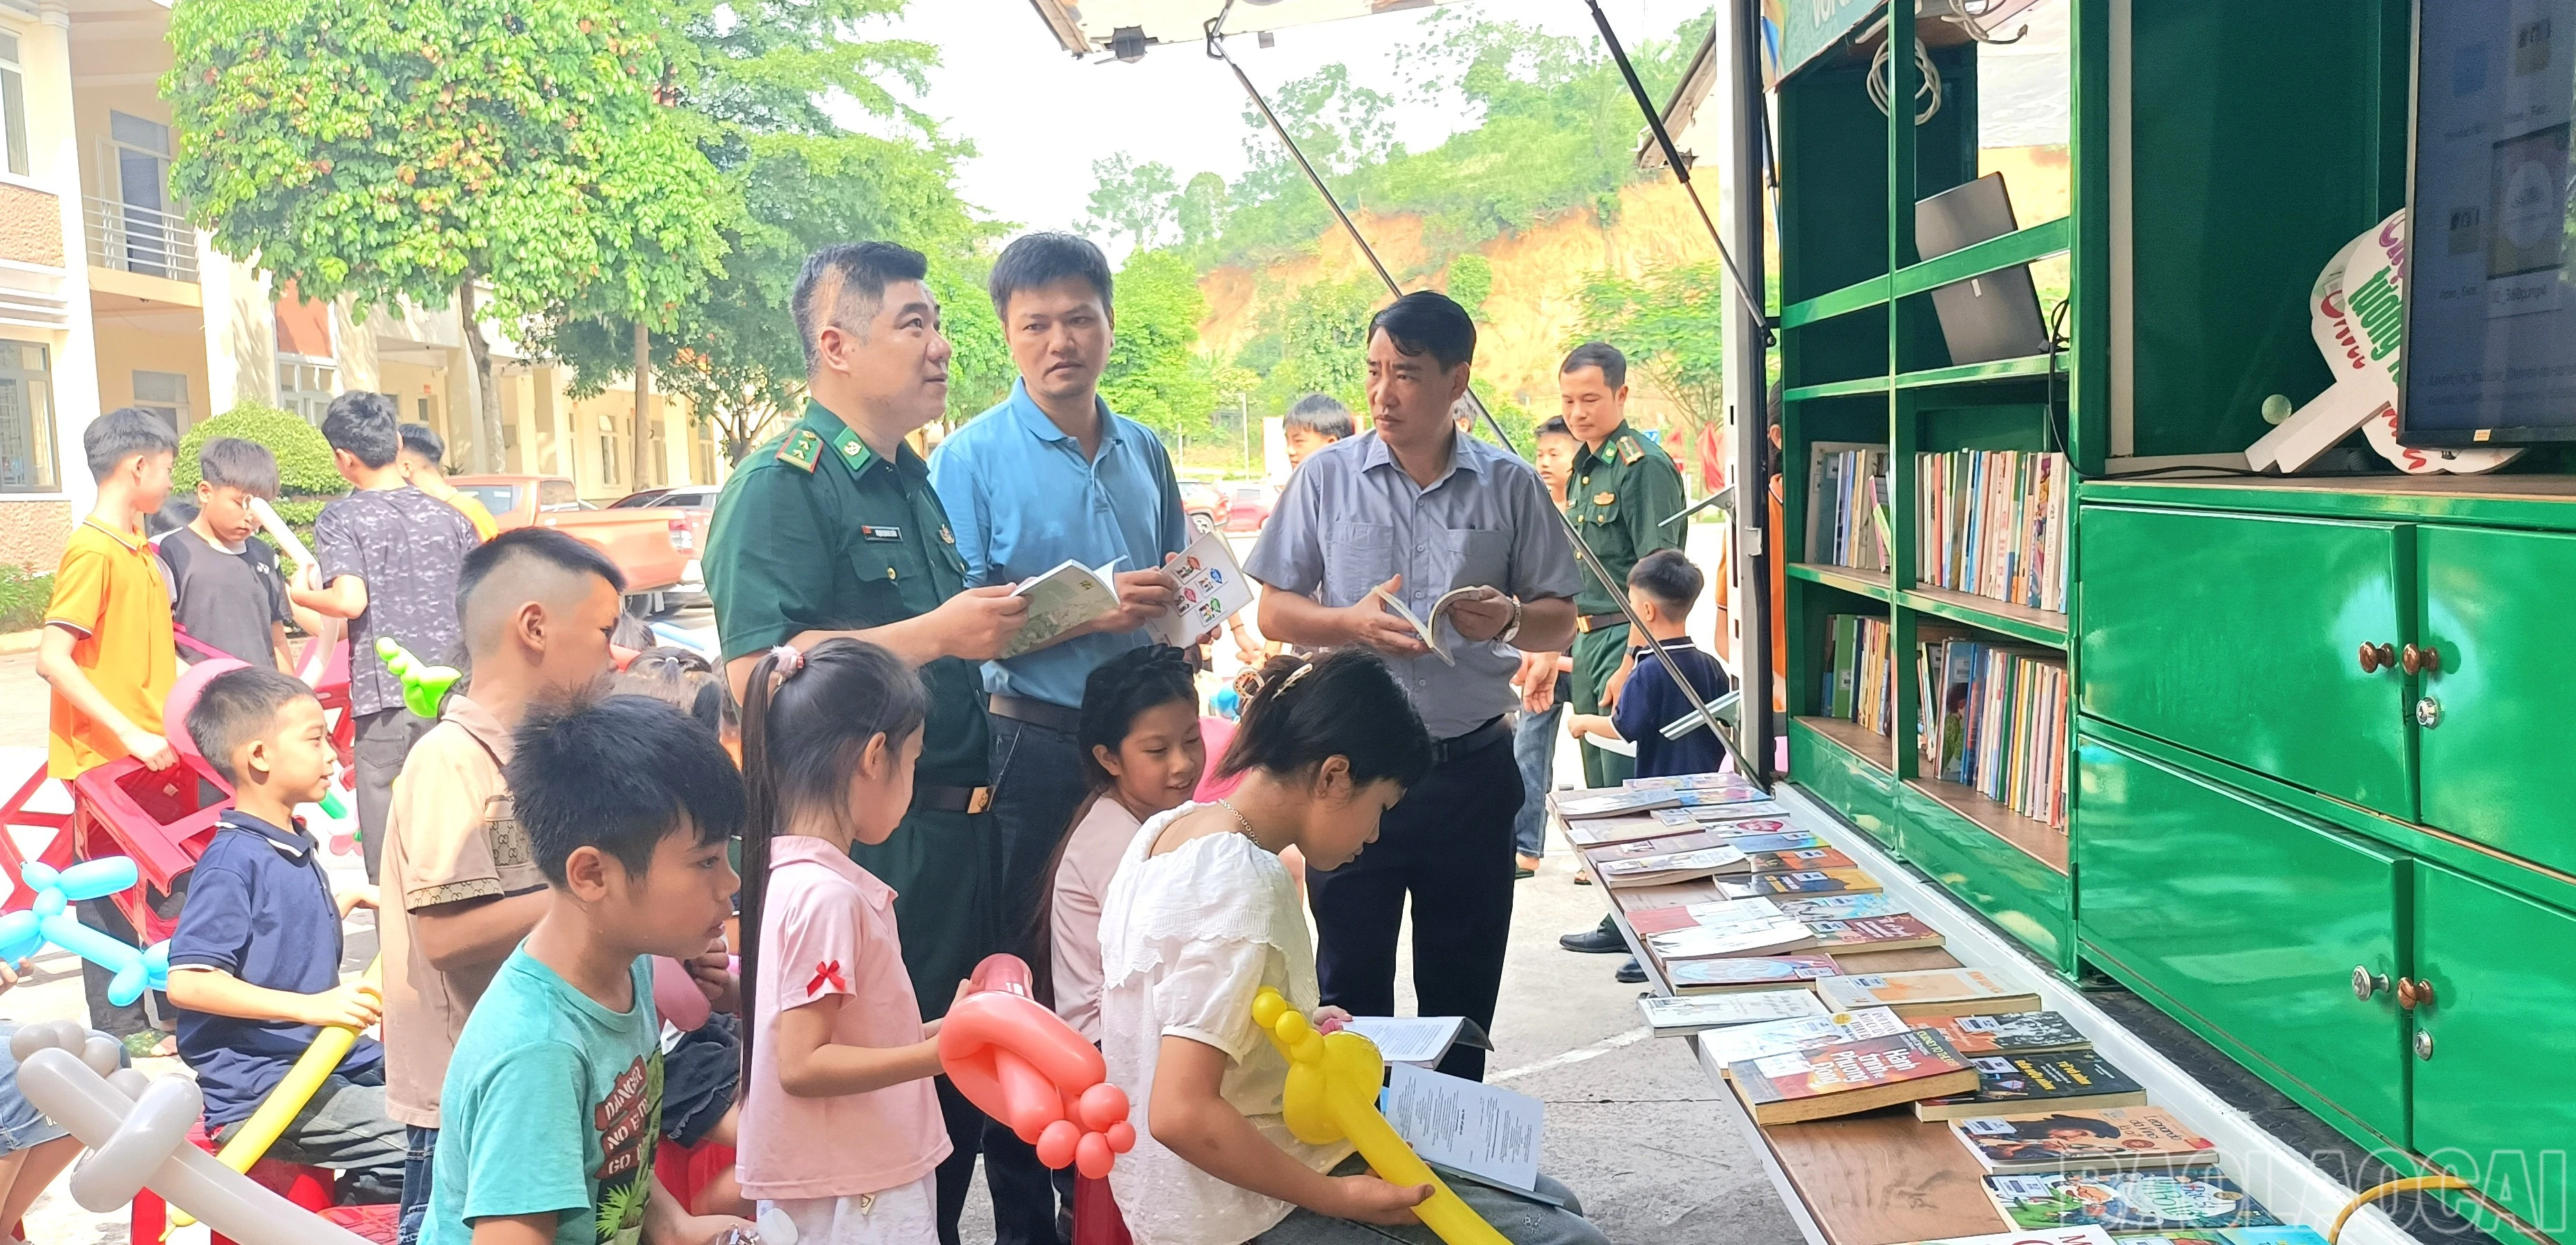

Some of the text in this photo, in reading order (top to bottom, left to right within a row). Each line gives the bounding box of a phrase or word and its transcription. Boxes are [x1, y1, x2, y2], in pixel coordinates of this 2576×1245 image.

[1858, 1053, 1894, 1074] trình
[1882, 1048, 1922, 1071] Hành
[607, 1125, 629, 1150] NO
[2143, 1115, 2182, 1141] Leonardo
[608, 1154, 631, 1174] GO
